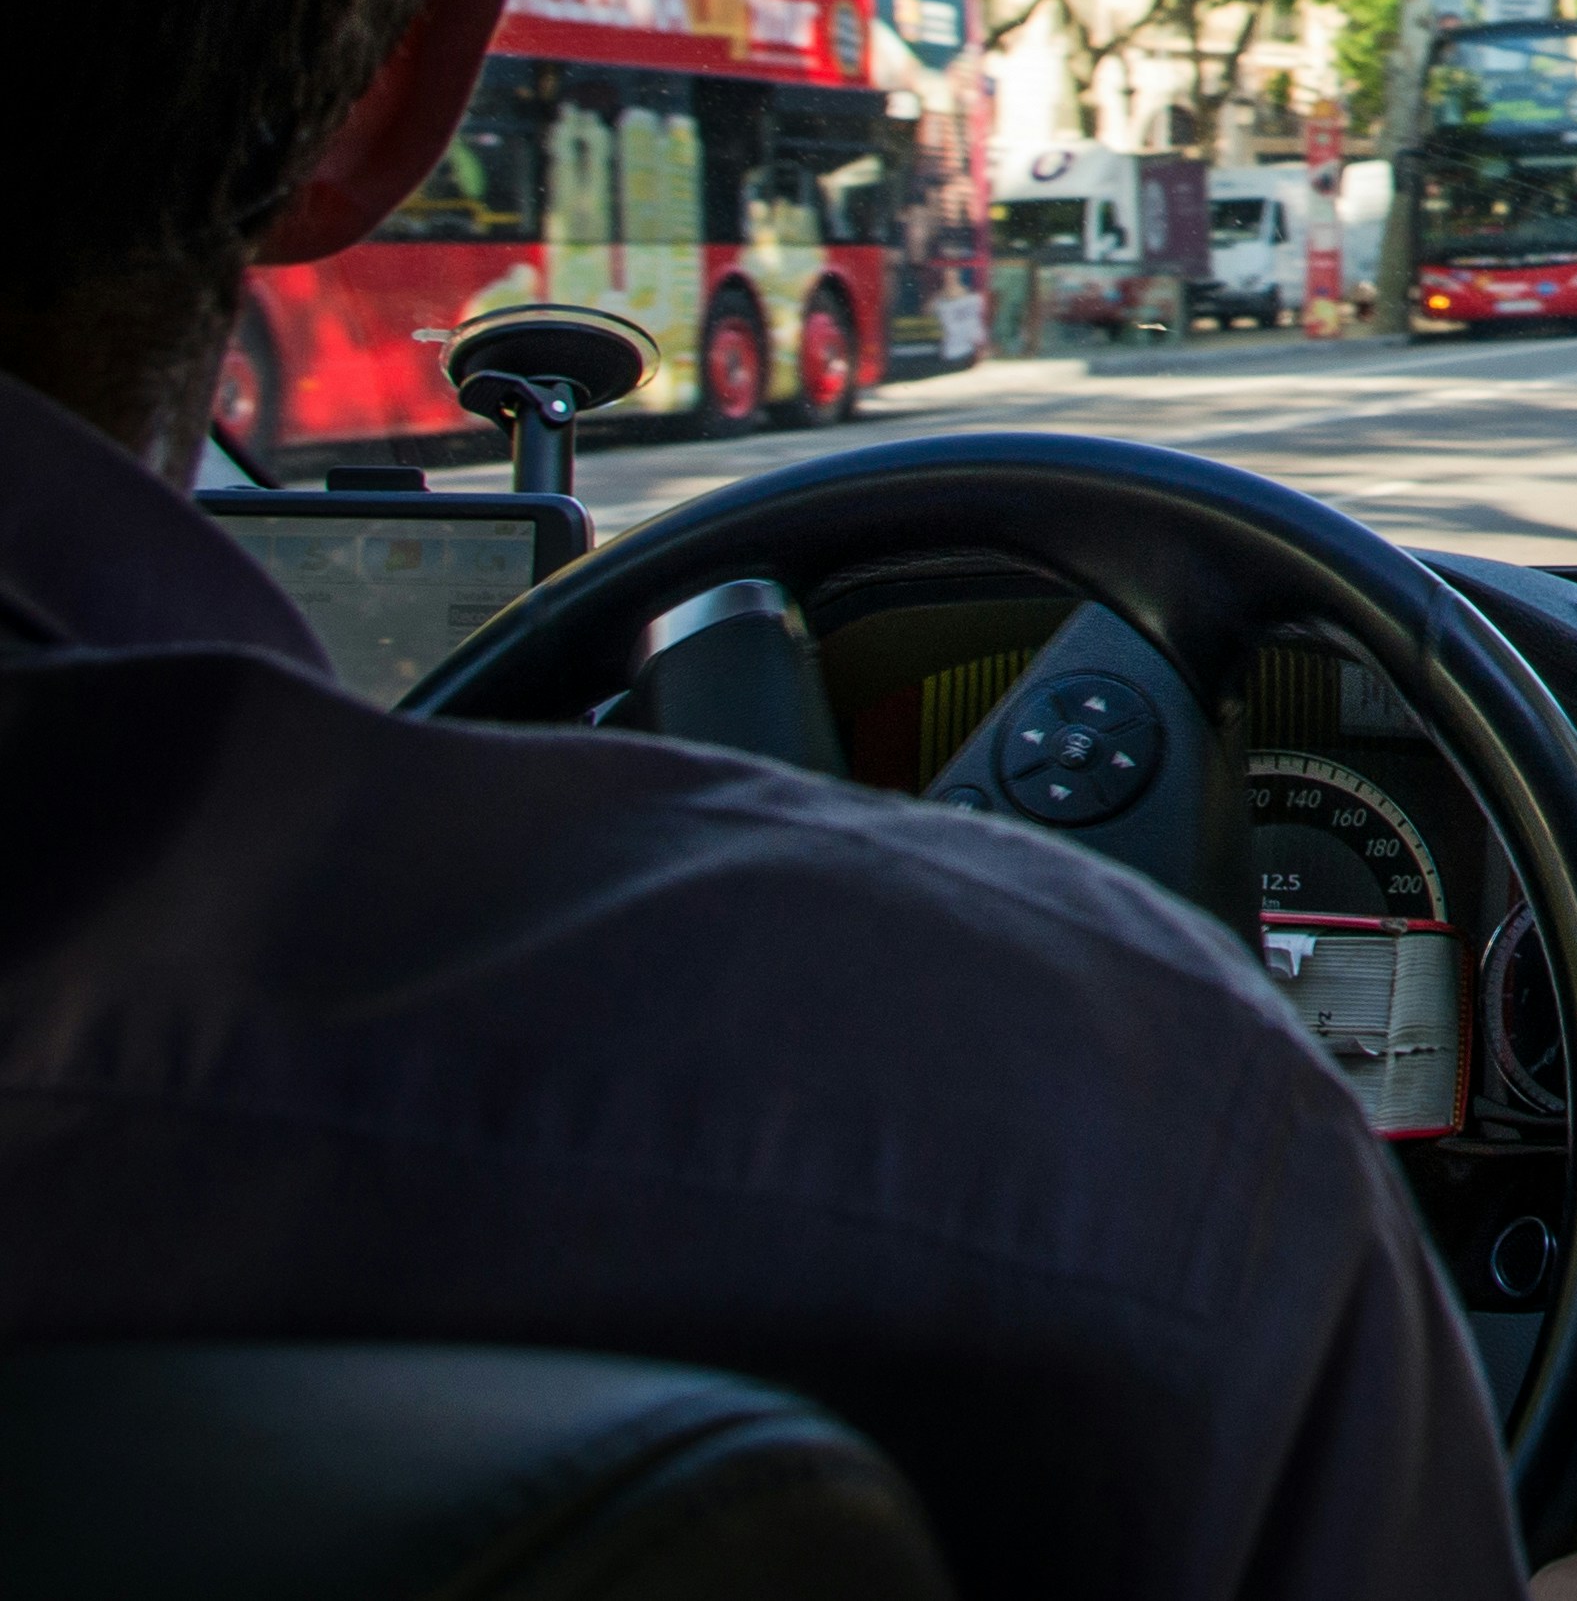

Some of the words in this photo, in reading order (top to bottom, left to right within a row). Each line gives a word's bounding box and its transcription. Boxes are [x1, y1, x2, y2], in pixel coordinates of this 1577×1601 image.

[1247, 788, 1271, 808] 20
[1285, 788, 1323, 809] 140
[1331, 808, 1368, 828] 160
[1365, 838, 1401, 858] 180
[1261, 873, 1302, 891] 12.5
[1387, 874, 1424, 895] 200
[1262, 896, 1281, 908] km
